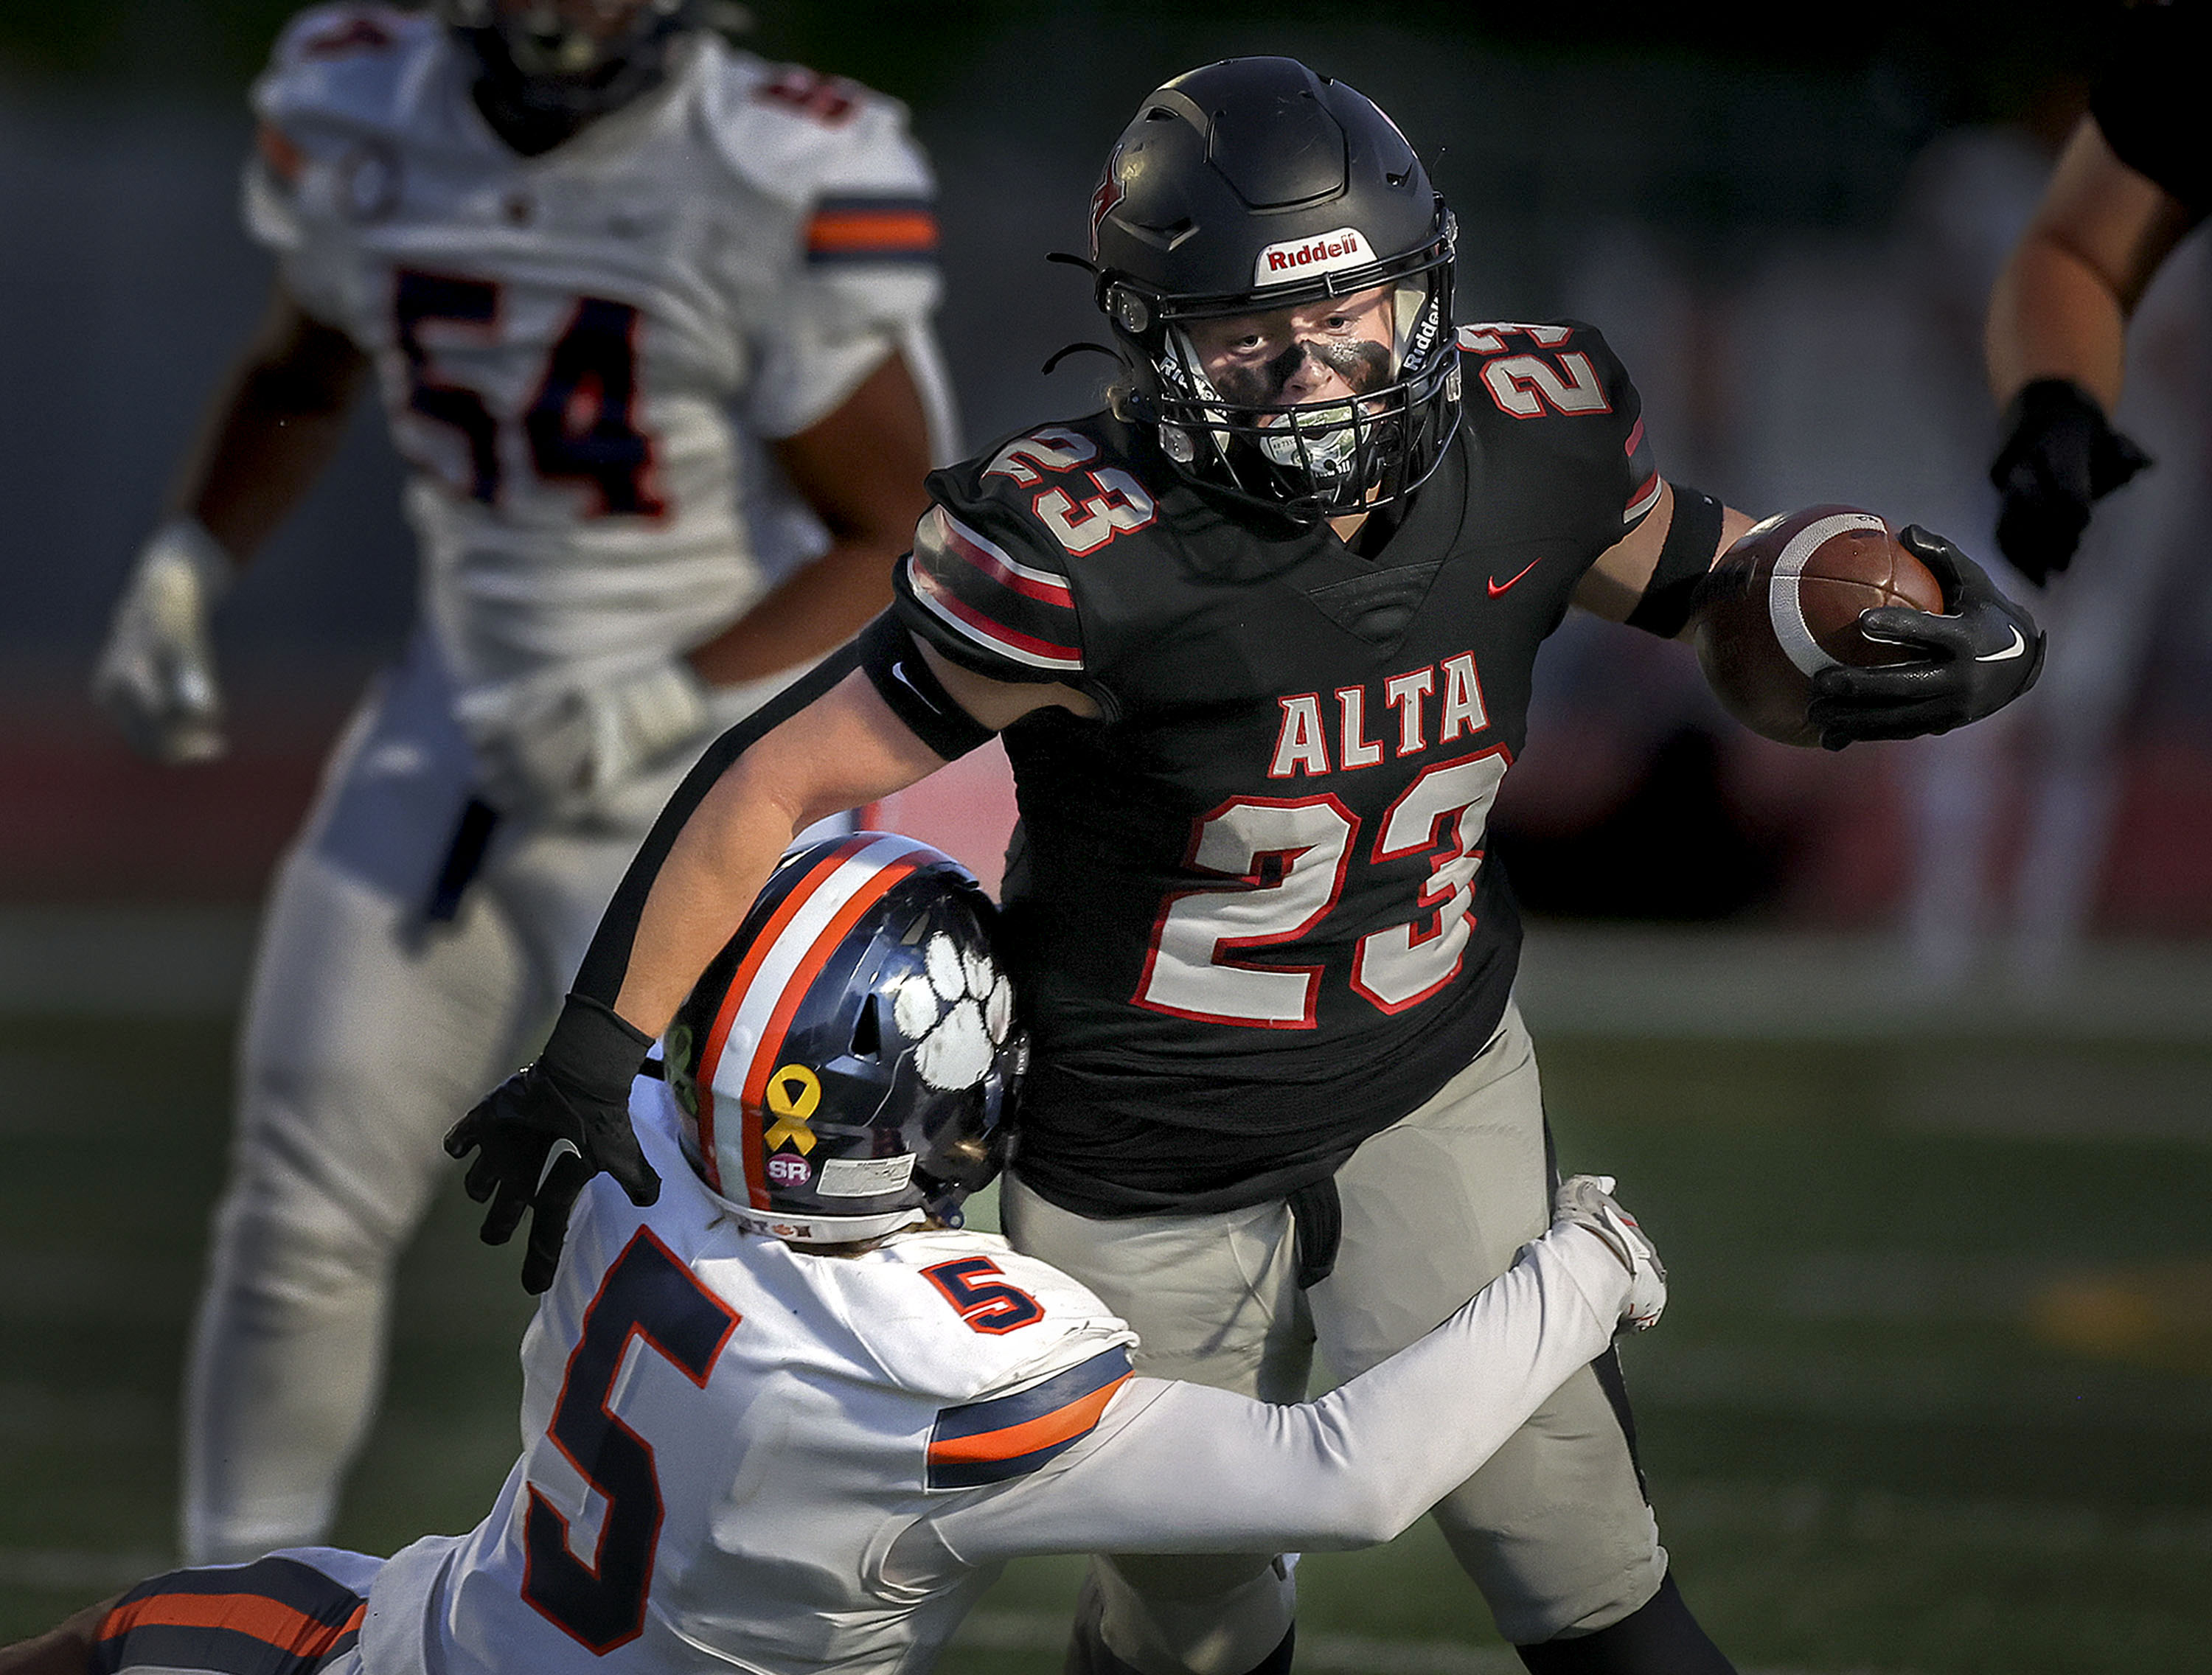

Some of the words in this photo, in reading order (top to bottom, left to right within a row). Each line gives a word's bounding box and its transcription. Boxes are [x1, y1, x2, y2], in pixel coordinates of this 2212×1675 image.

[1267, 233, 1357, 271] Riddell
[394, 264, 674, 525] 54
[978, 426, 1161, 558] 23
[1267, 650, 1490, 779] ALTA
[1129, 742, 1514, 1030] 23
[769, 1160, 807, 1180] SR
[920, 1255, 1046, 1335] 5
[520, 1223, 742, 1657] 5
